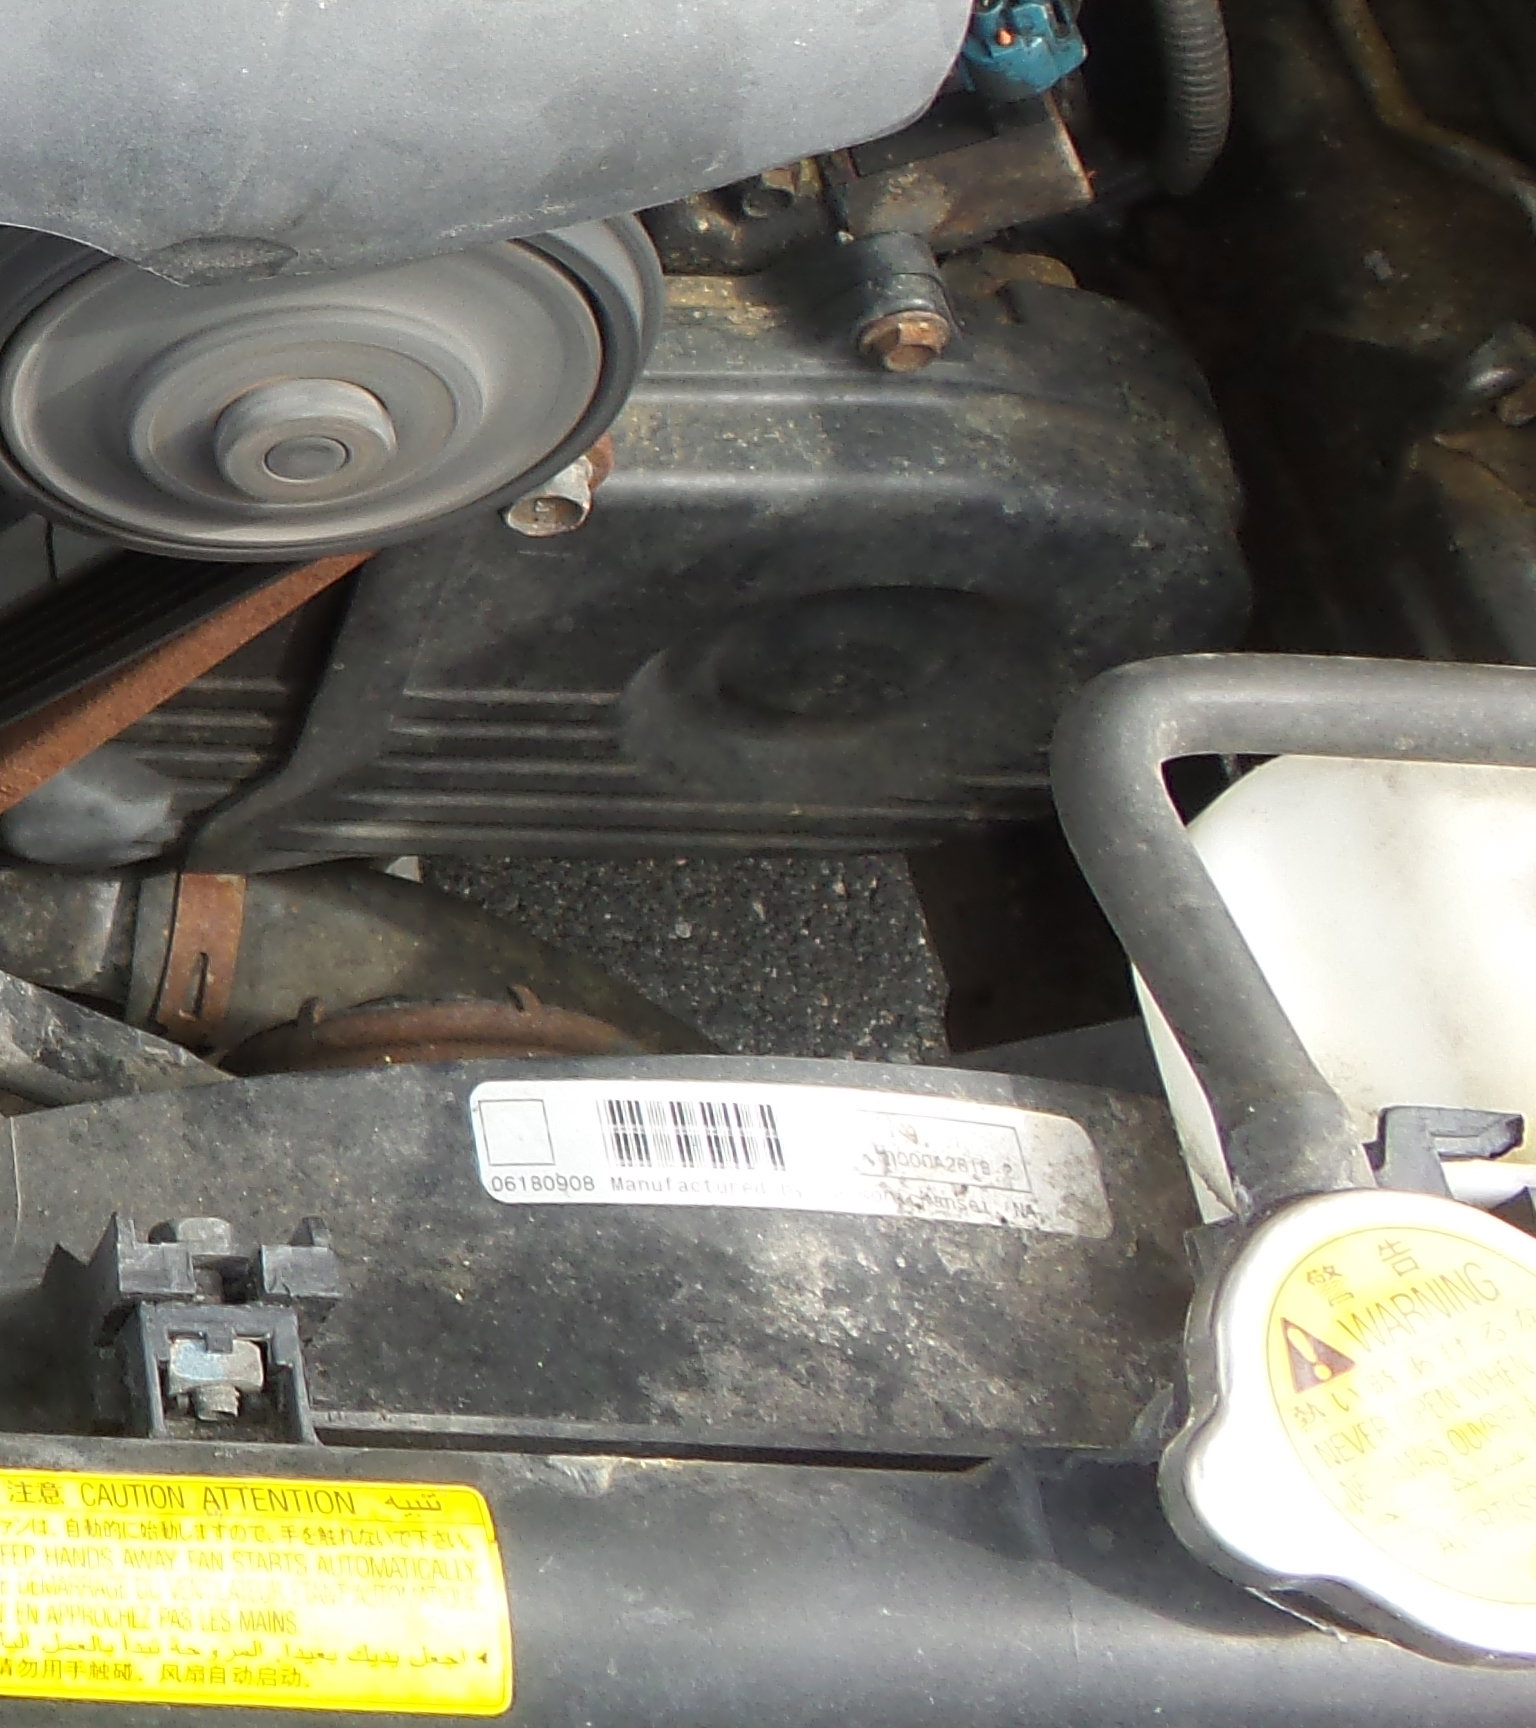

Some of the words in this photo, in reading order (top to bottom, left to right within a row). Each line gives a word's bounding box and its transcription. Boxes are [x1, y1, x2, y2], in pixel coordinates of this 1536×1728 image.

[490, 1175, 596, 1193] 06180908
[1306, 1239, 1421, 1307] 警告
[1336, 1261, 1501, 1352] WARNING
[1313, 1415, 1394, 1470] NEVER
[7, 1480, 64, 1504] 注意
[80, 1482, 186, 1509] CAUTION
[203, 1485, 357, 1515] ATTENTION
[44, 1545, 115, 1570] HANDS
[188, 1549, 225, 1571] FAN
[231, 1551, 306, 1576] STARTS
[159, 1606, 192, 1631] PAS
